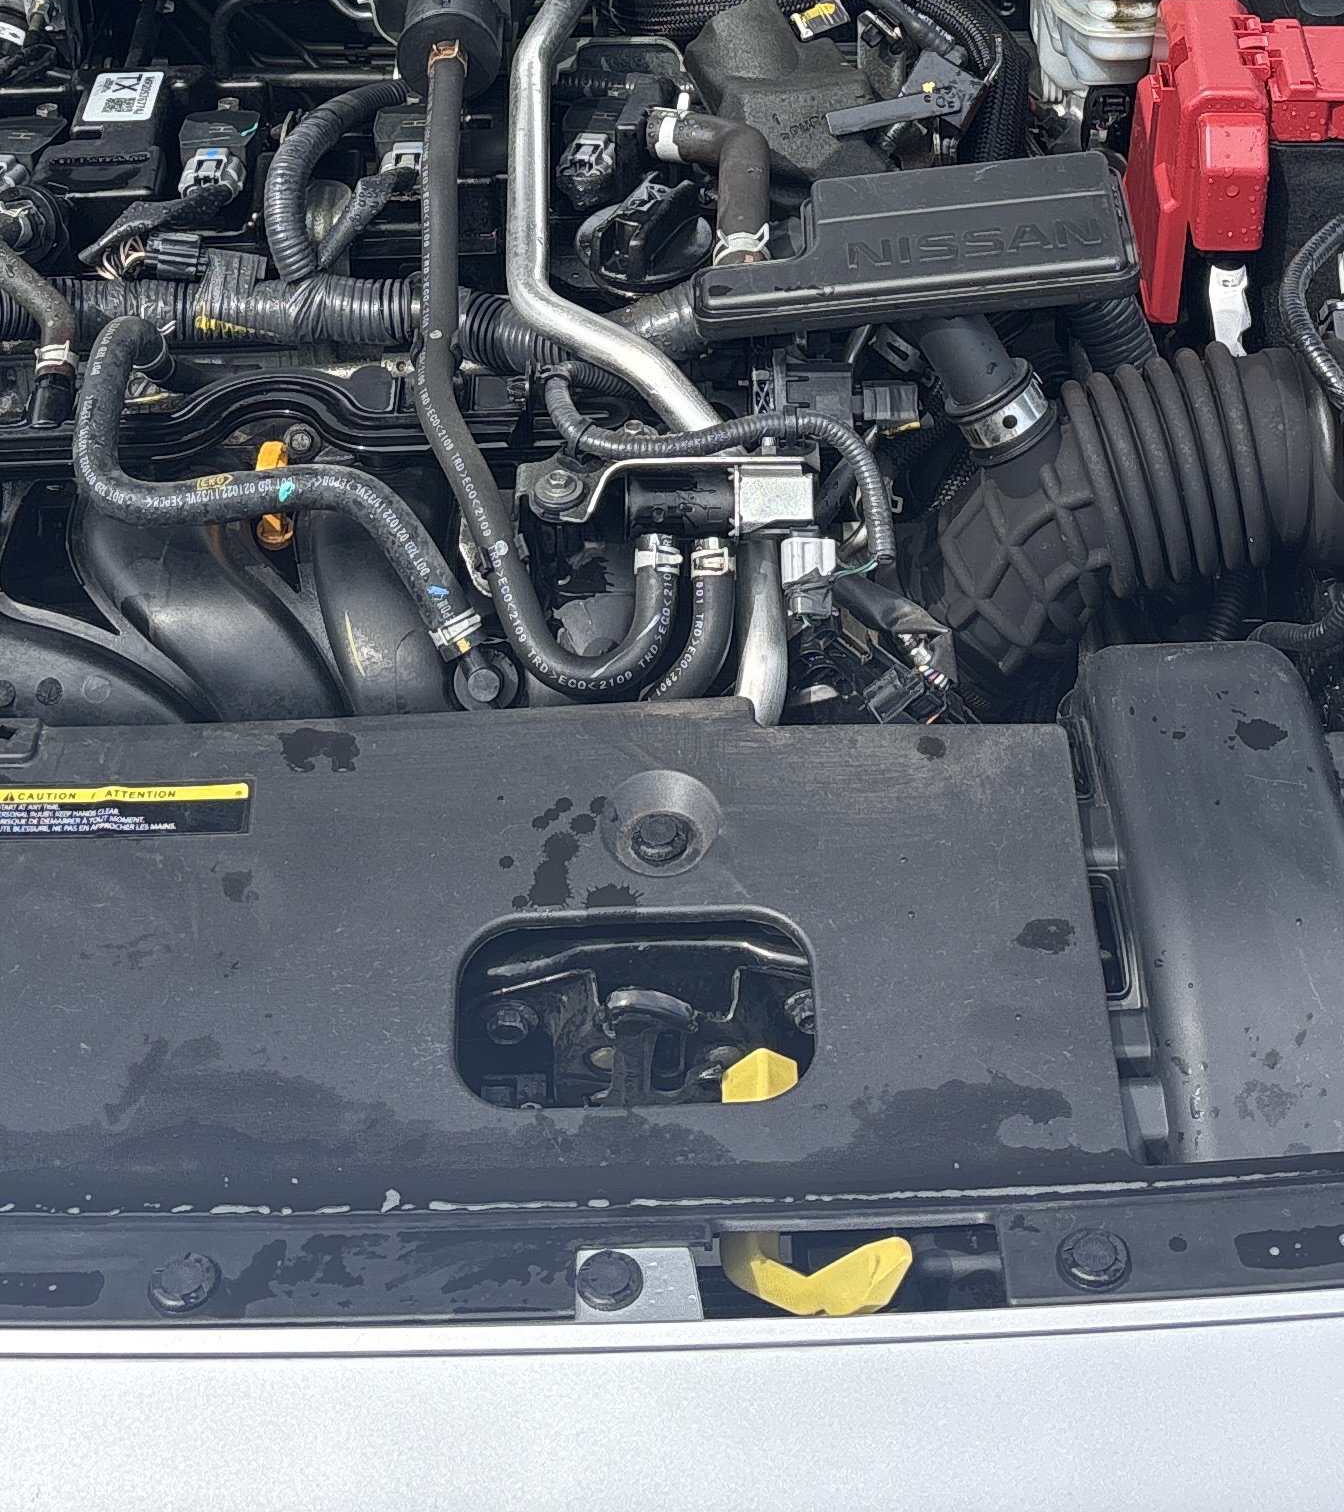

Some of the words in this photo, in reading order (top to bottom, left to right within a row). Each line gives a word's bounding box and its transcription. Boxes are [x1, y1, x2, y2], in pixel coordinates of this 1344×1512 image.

[846, 218, 1104, 270] NISSAN
[526, 648, 634, 691] TRD>ECO<2109
[17, 792, 77, 801] CAUTION
[105, 789, 177, 800] ATTENTION
